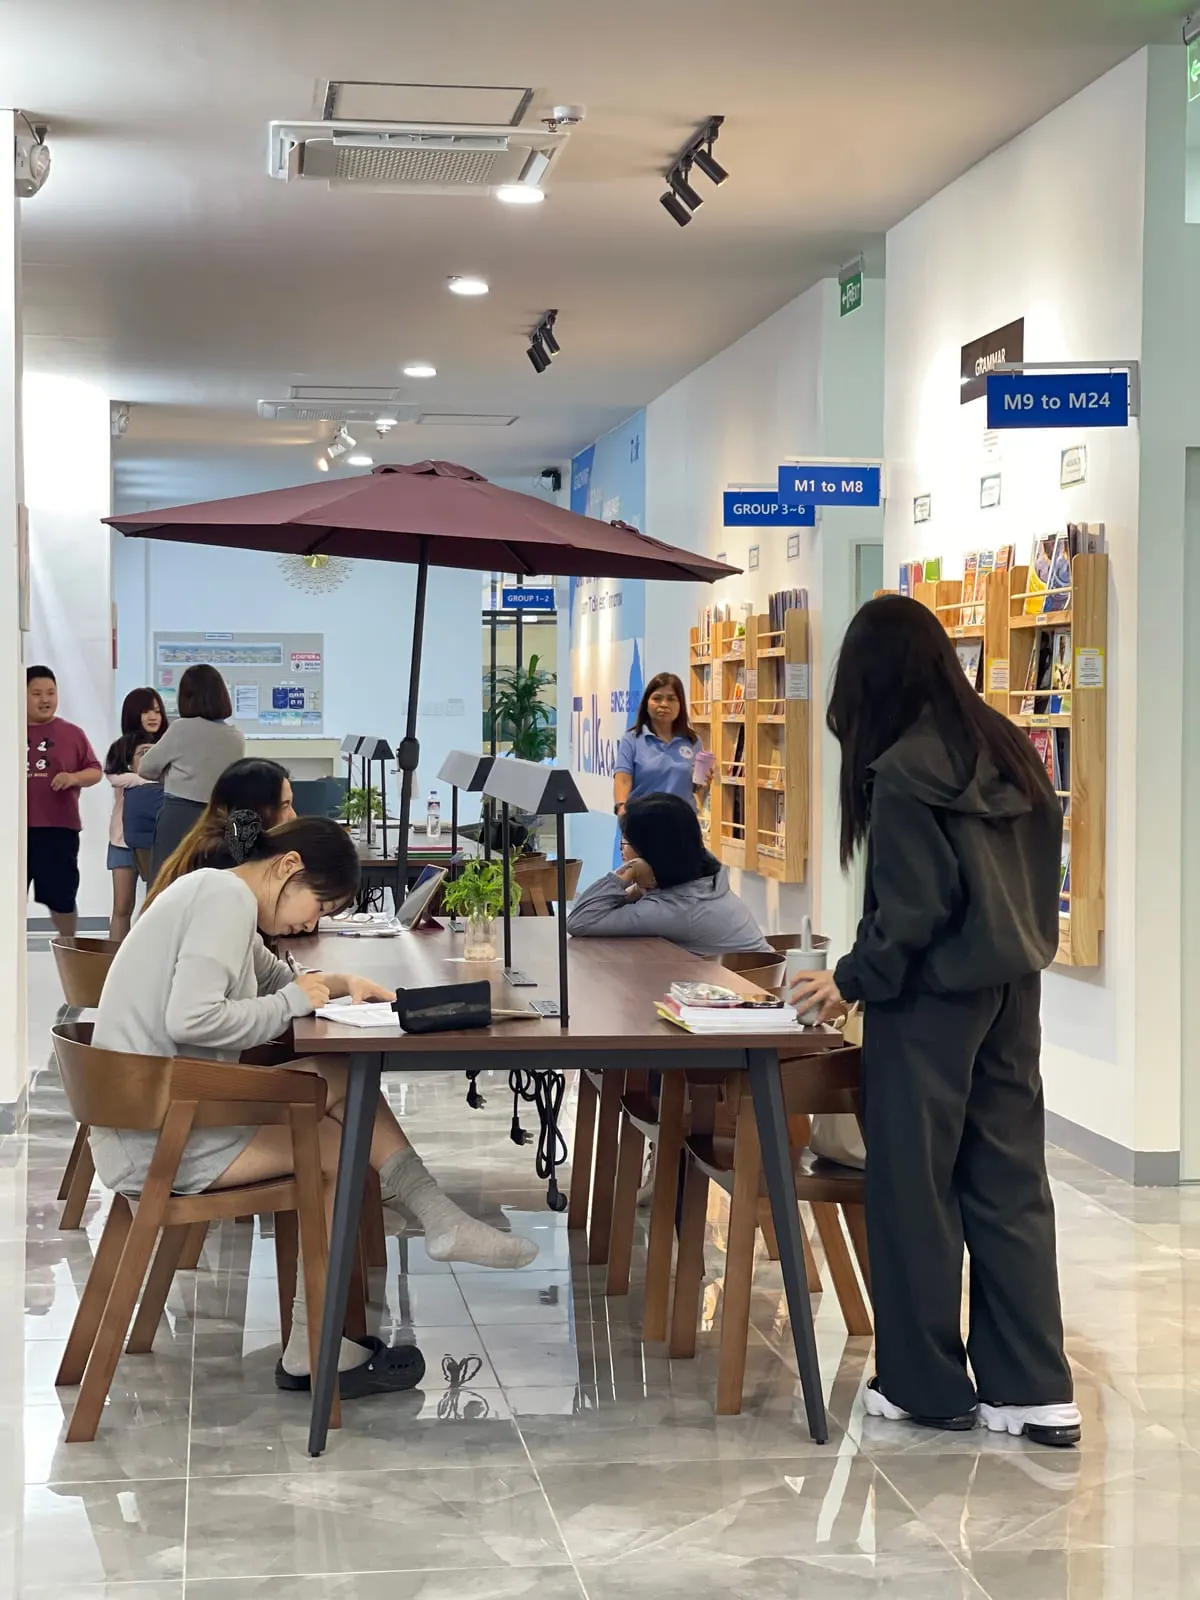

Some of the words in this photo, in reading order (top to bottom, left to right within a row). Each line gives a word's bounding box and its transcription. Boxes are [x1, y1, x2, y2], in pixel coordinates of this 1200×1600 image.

[975, 347, 1006, 376] GRAMMAR
[1004, 393, 1034, 411] M9
[1041, 394, 1061, 410] to
[1068, 392, 1111, 409] M24
[794, 479, 815, 492] M1
[821, 480, 836, 493] to
[841, 480, 864, 493] M8
[733, 503, 778, 515] GROUP
[507, 594, 534, 602] GROUP
